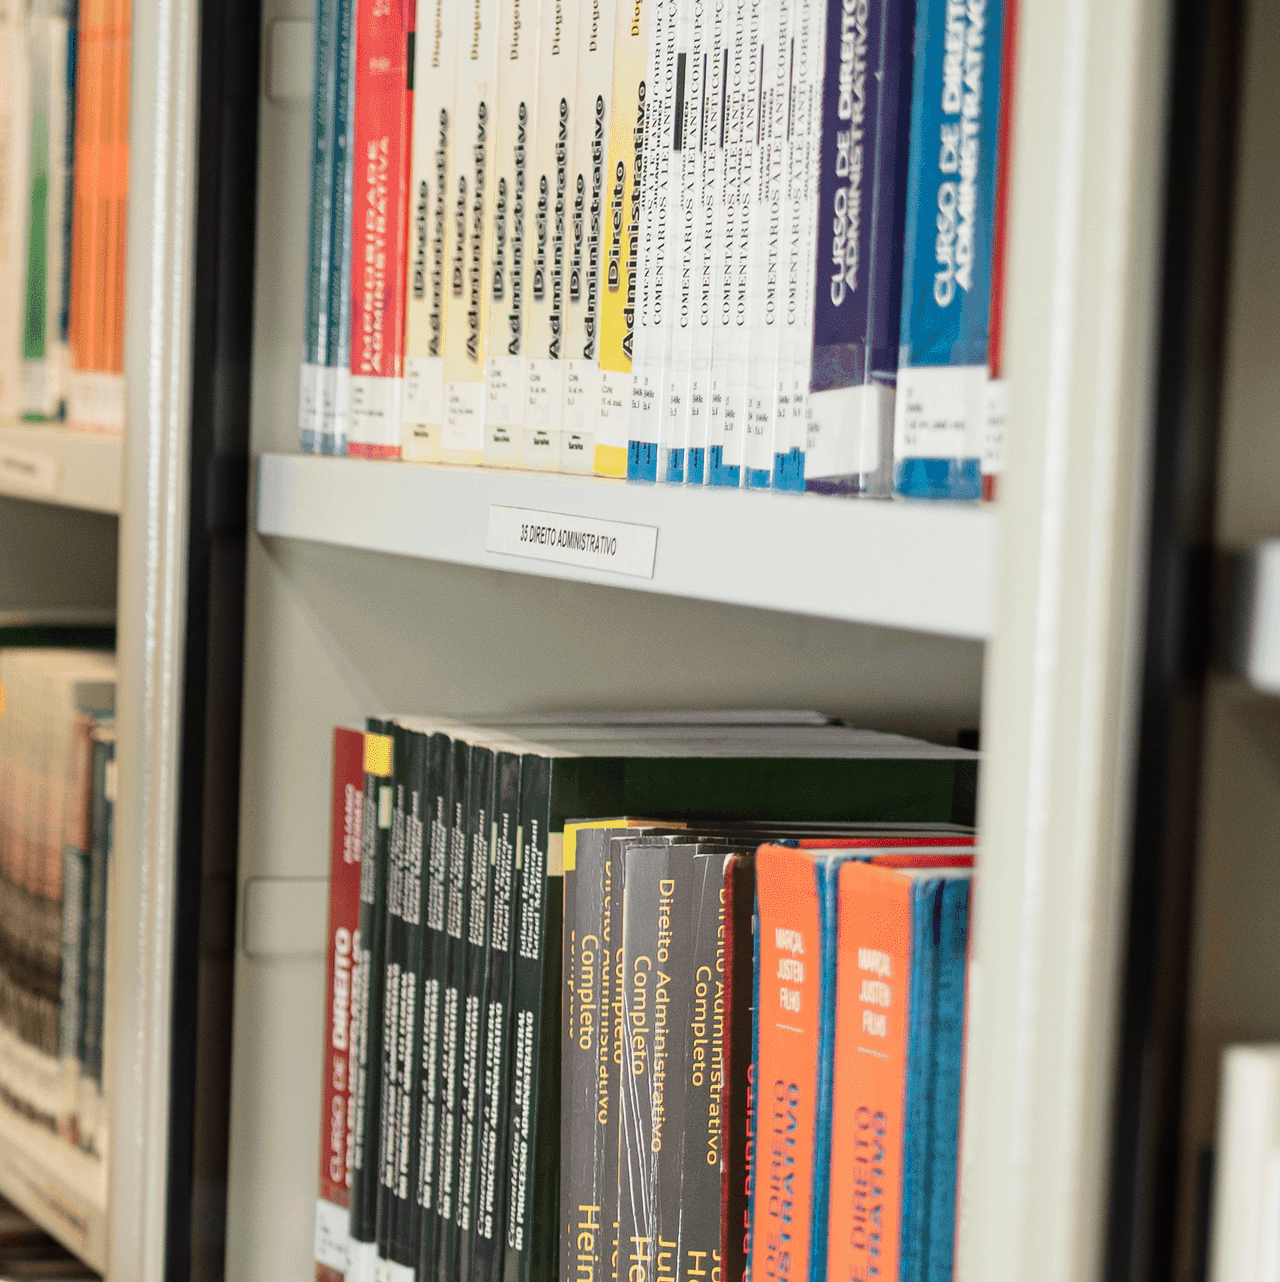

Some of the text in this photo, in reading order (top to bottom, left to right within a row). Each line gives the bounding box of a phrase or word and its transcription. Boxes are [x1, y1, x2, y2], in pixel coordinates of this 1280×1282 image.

[836, 130, 851, 177] DE
[939, 121, 960, 176] DE
[452, 175, 468, 297] Direito
[466, 102, 487, 363] Administrativo
[493, 178, 507, 300] Direito
[508, 101, 526, 355] Administrativo
[534, 175, 548, 301] Direito
[549, 98, 568, 360] Administrativo
[570, 174, 585, 301] Direito
[583, 95, 604, 360] Administrativo
[607, 161, 625, 291] Direito
[622, 80, 646, 361] Administrativo
[654, 194, 667, 326] COMENTÁRIOS
[662, 143, 670, 174] LEI
[680, 195, 694, 328] COMENTÁRIOS
[688, 143, 696, 176] LEI
[700, 193, 714, 327] COMENTÁRIOS
[721, 191, 736, 327] COMENTÁRIOS
[730, 139, 738, 171] LEI
[831, 187, 849, 307] CURSO
[933, 182, 957, 308] CURSO
[520, 523, 617, 556] 35 DIREITO ADMINISTRATIVO
[520, 844, 531, 958] Juliano Heinen
[332, 926, 351, 1050] DIREITO
[579, 934, 599, 1051] Completo
[631, 955, 652, 1076] Completo
[650, 878, 676, 1154] Direito Administrativo
[691, 965, 712, 1088] Completo
[776, 958, 806, 984] JUSTEN
[515, 1080, 523, 1106] LEI
[516, 1009, 526, 1077] FEDERAL
[515, 1011, 534, 1251] DO PROCESSO ADMINISTRATIVO
[768, 1079, 788, 1218] DIREITO
[851, 1106, 872, 1250] DIREITO
[765, 1231, 781, 1279] DE
